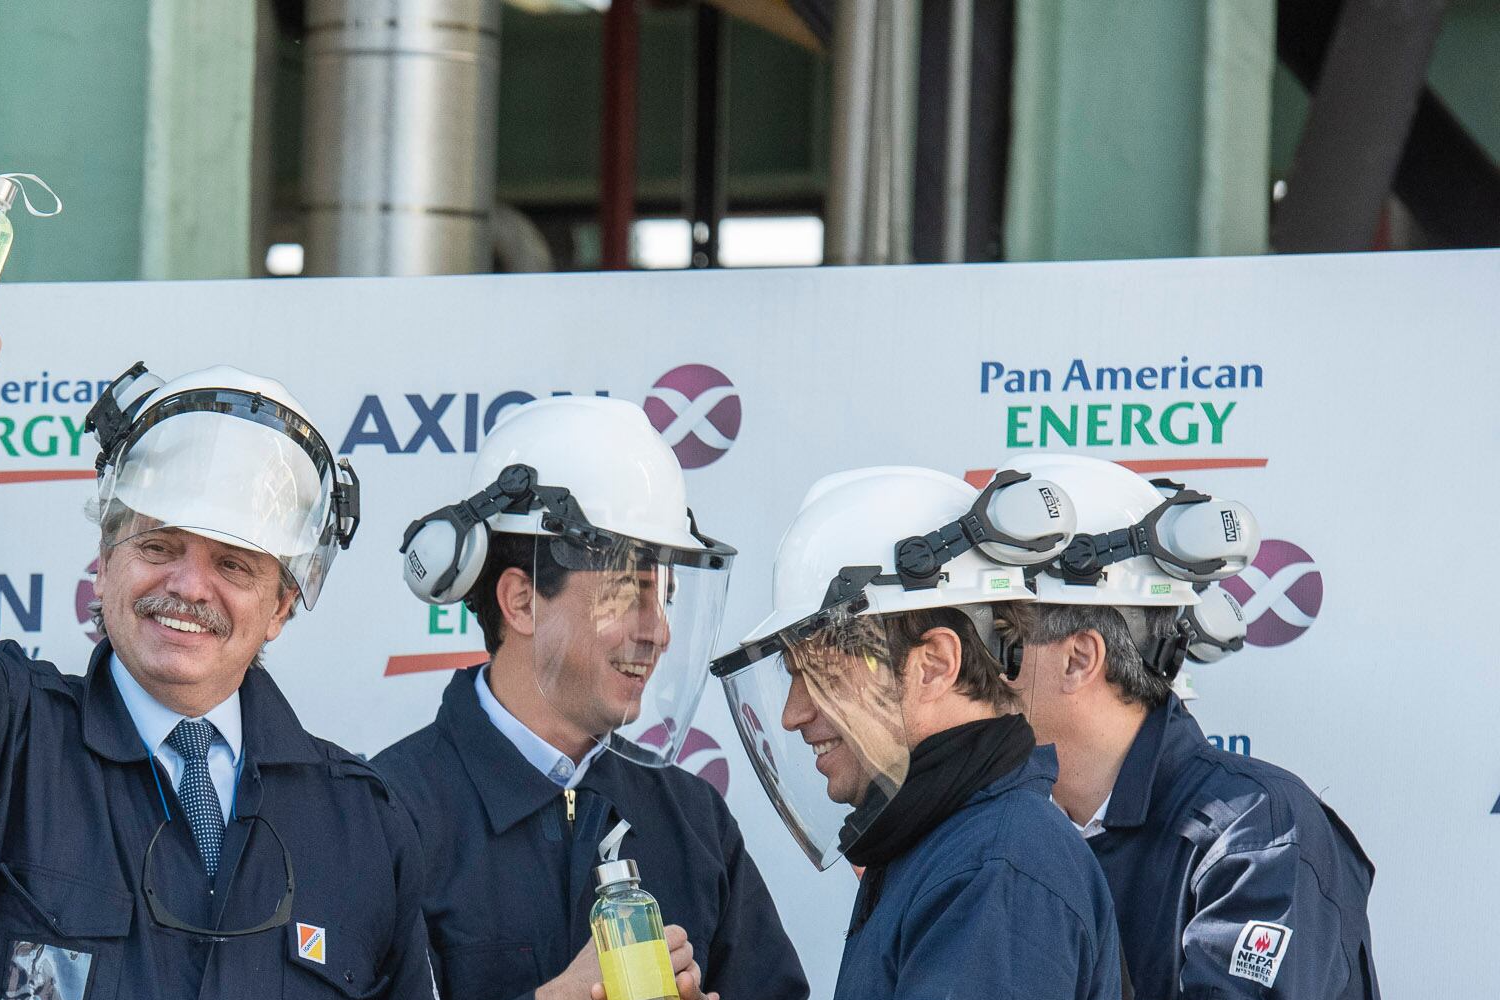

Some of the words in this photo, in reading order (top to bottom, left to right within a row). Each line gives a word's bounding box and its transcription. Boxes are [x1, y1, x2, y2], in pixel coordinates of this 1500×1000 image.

[980, 361, 1052, 393] Pan
[1061, 355, 1263, 392] American
[1006, 401, 1237, 448] ENERGY
[1039, 488, 1059, 518] MSA
[1221, 510, 1237, 541] MSA
[1236, 960, 1272, 977] MEMBER
[1238, 951, 1273, 969] NFPA
